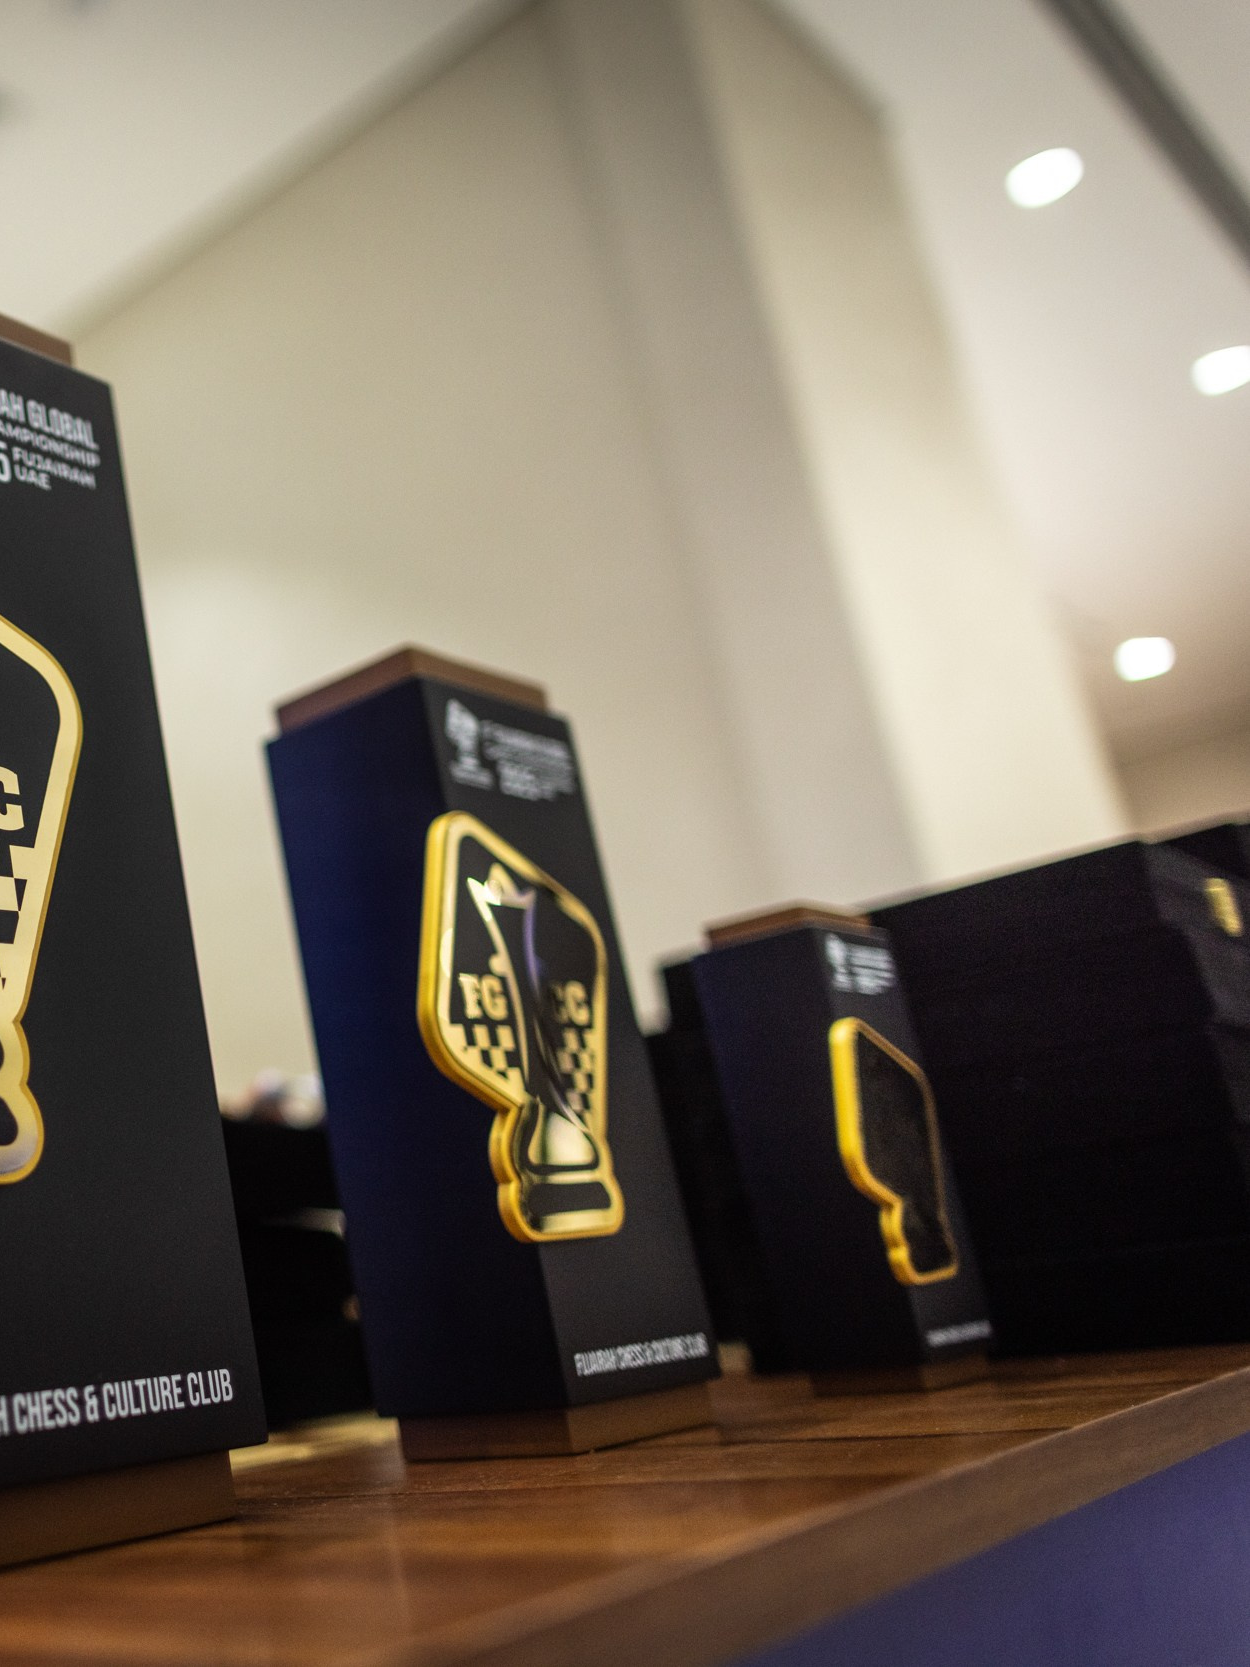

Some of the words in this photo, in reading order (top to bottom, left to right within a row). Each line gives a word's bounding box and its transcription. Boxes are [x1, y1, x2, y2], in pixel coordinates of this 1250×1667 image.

[26, 398, 100, 452] GLOBAL
[13, 462, 52, 491] UAE
[13, 1386, 81, 1435] CHESS
[83, 1384, 100, 1423] &
[101, 1373, 185, 1421] CULTURE
[186, 1367, 234, 1407] CLUB
